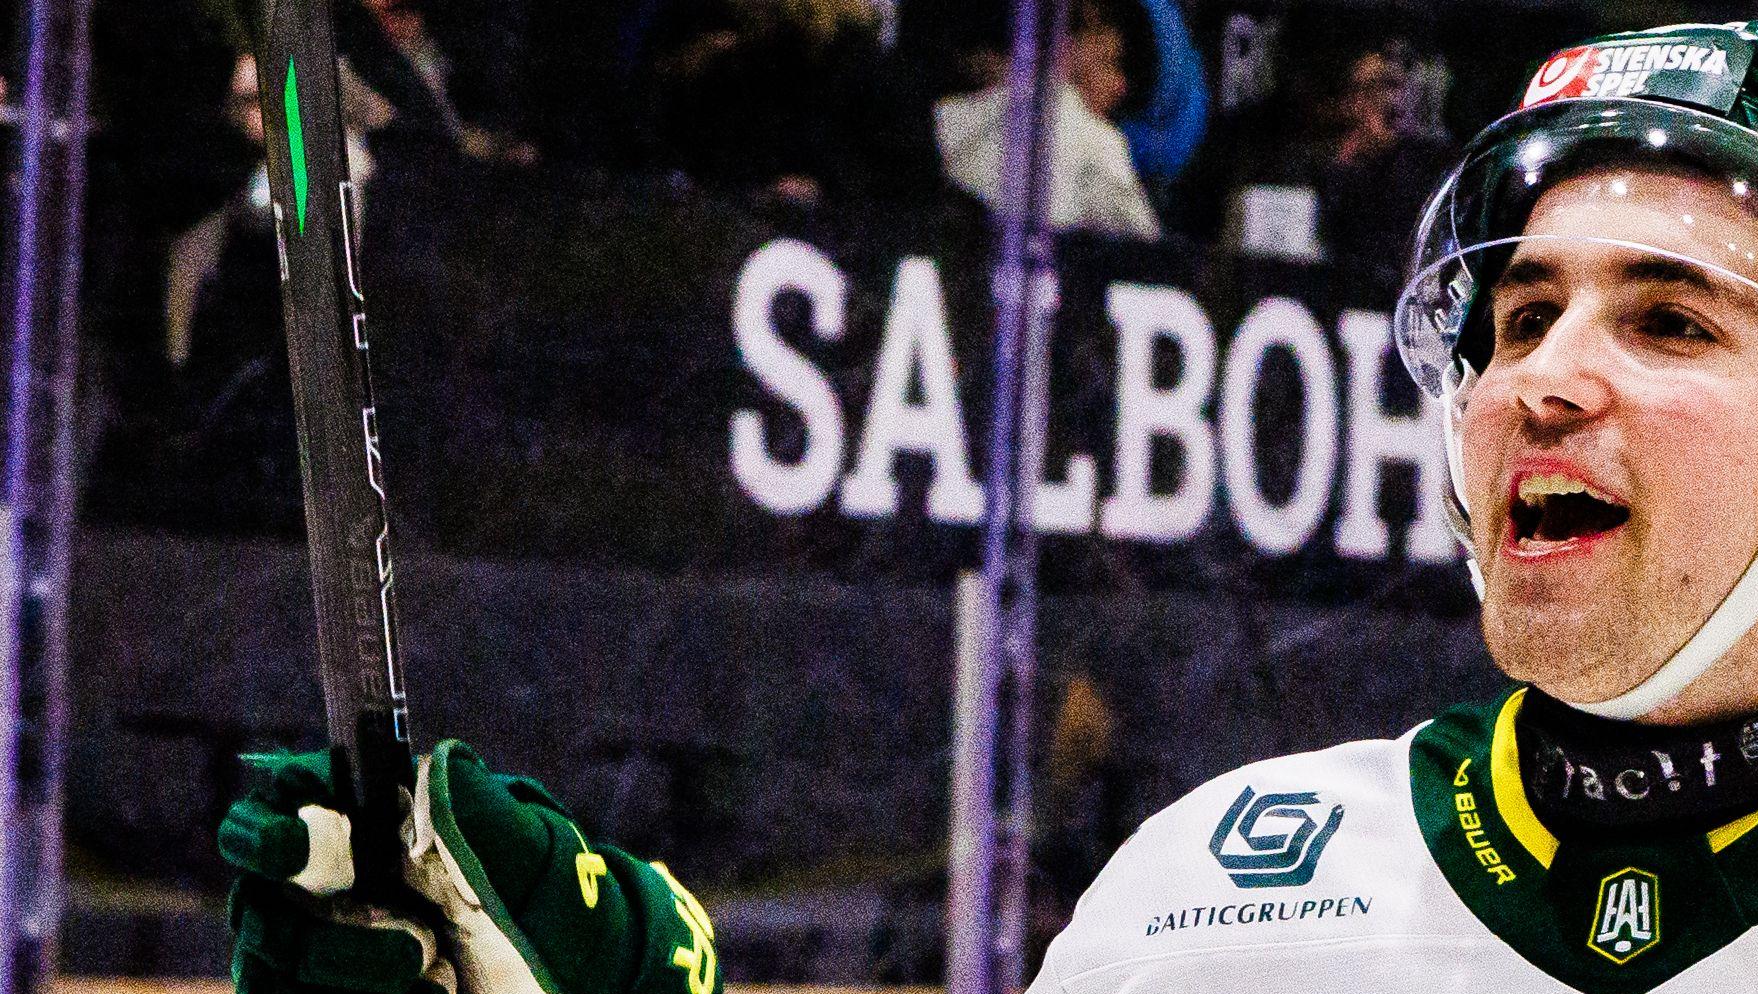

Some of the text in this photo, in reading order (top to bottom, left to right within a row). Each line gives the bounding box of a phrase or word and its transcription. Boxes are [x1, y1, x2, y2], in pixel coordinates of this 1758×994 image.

[1595, 44, 1729, 75] SVENSKA
[1580, 70, 1650, 97] SPEL
[1146, 896, 1373, 937] BALTICGRUPPEN
